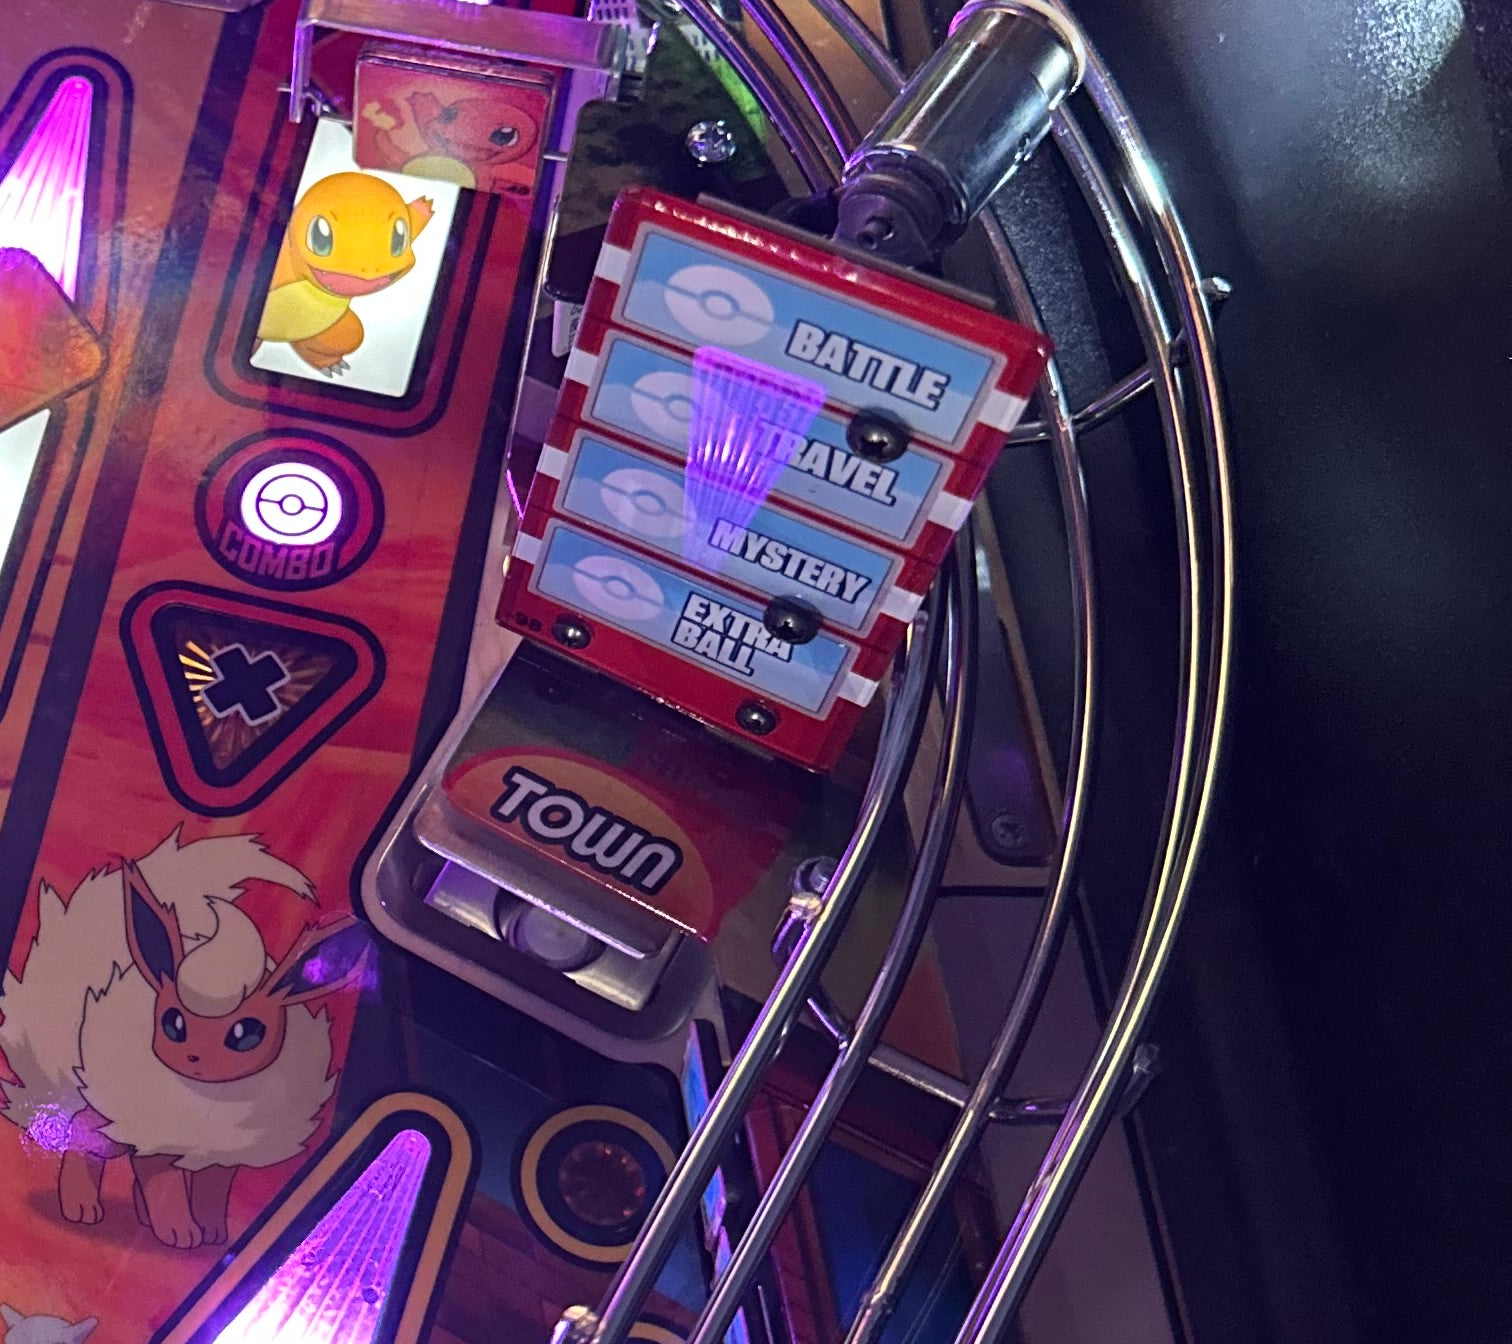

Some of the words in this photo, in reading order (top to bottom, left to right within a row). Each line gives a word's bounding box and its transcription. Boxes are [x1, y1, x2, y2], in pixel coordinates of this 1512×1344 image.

[784, 318, 952, 412] BATTLE
[754, 418, 900, 507] TRAVEL
[218, 519, 336, 581] COMBO
[708, 517, 873, 605] MYSTERY
[671, 618, 755, 678] BALL
[495, 769, 679, 891] TOWN
